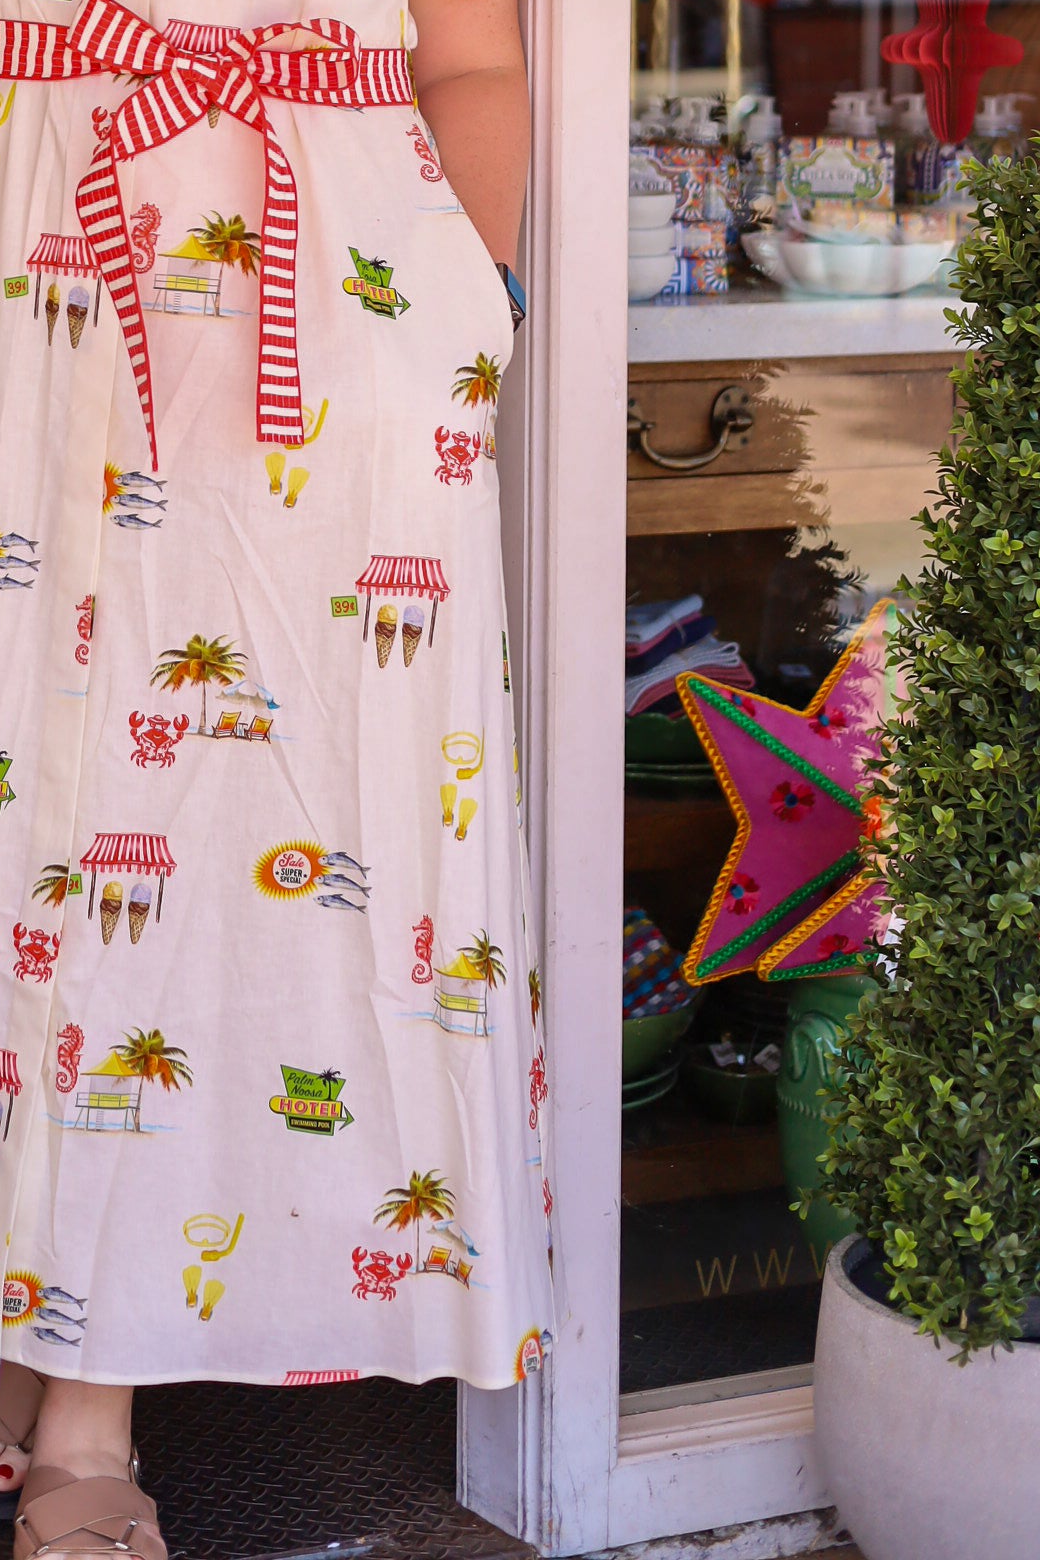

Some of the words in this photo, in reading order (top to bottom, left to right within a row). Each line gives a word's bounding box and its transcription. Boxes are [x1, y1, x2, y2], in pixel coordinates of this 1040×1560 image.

[353, 280, 395, 303] HTEL
[334, 600, 355, 614] 39¢
[278, 853, 305, 867] Sale
[280, 868, 303, 878] SUPER
[280, 876, 301, 884] SPECIAL
[287, 1072, 314, 1085] Palm
[291, 1084, 323, 1097] Noosa
[279, 1098, 339, 1117] HOTEL
[3, 1298, 22, 1306] UPER
[3, 1305, 20, 1313] PECIAL
